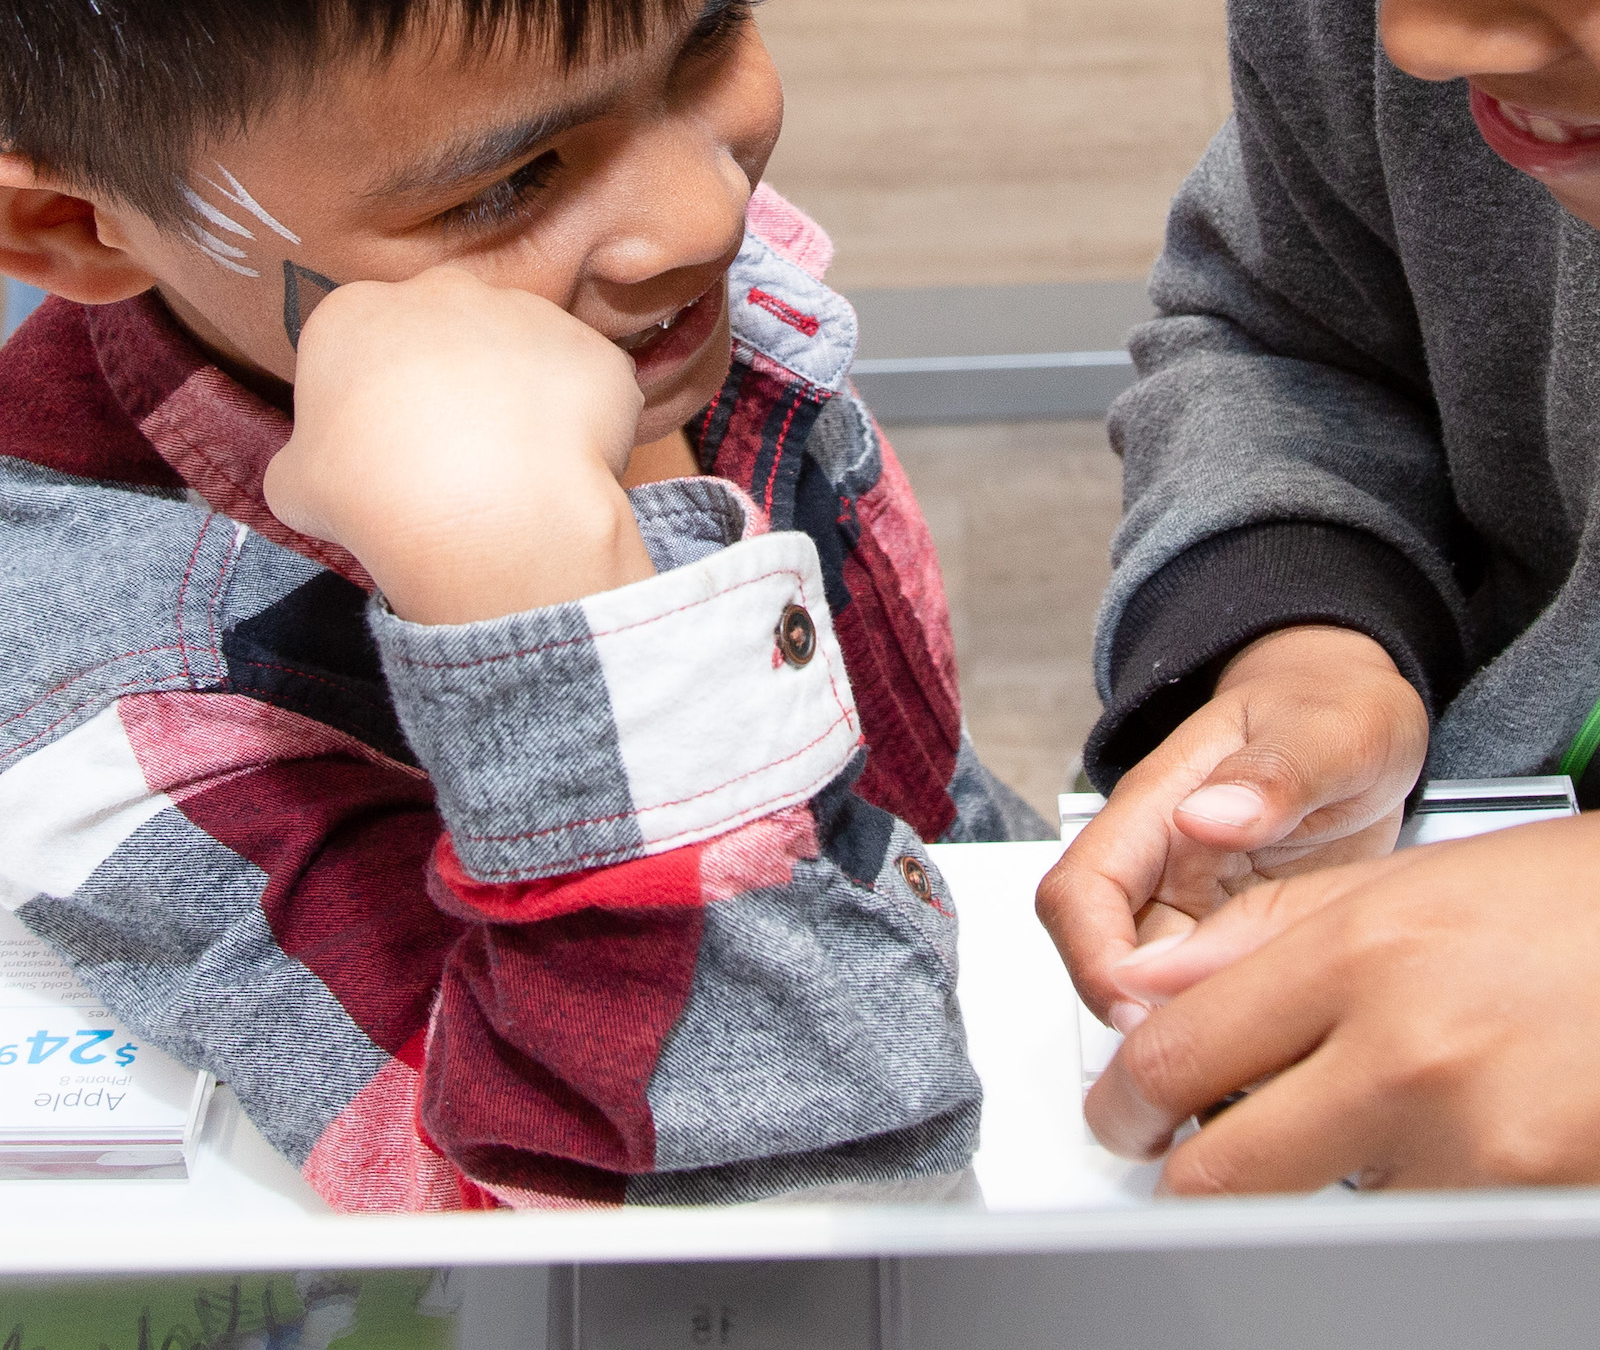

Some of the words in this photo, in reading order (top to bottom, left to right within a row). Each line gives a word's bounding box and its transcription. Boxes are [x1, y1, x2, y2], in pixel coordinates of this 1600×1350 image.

[22, 950, 40, 958] 4K
[3, 960, 53, 968] resistant
[6, 970, 70, 979] aluminum
[4, 981, 37, 990] Silver
[59, 1076, 71, 1086] 8
[75, 1074, 132, 1086] iPhone
[33, 1088, 127, 1112] Apple
